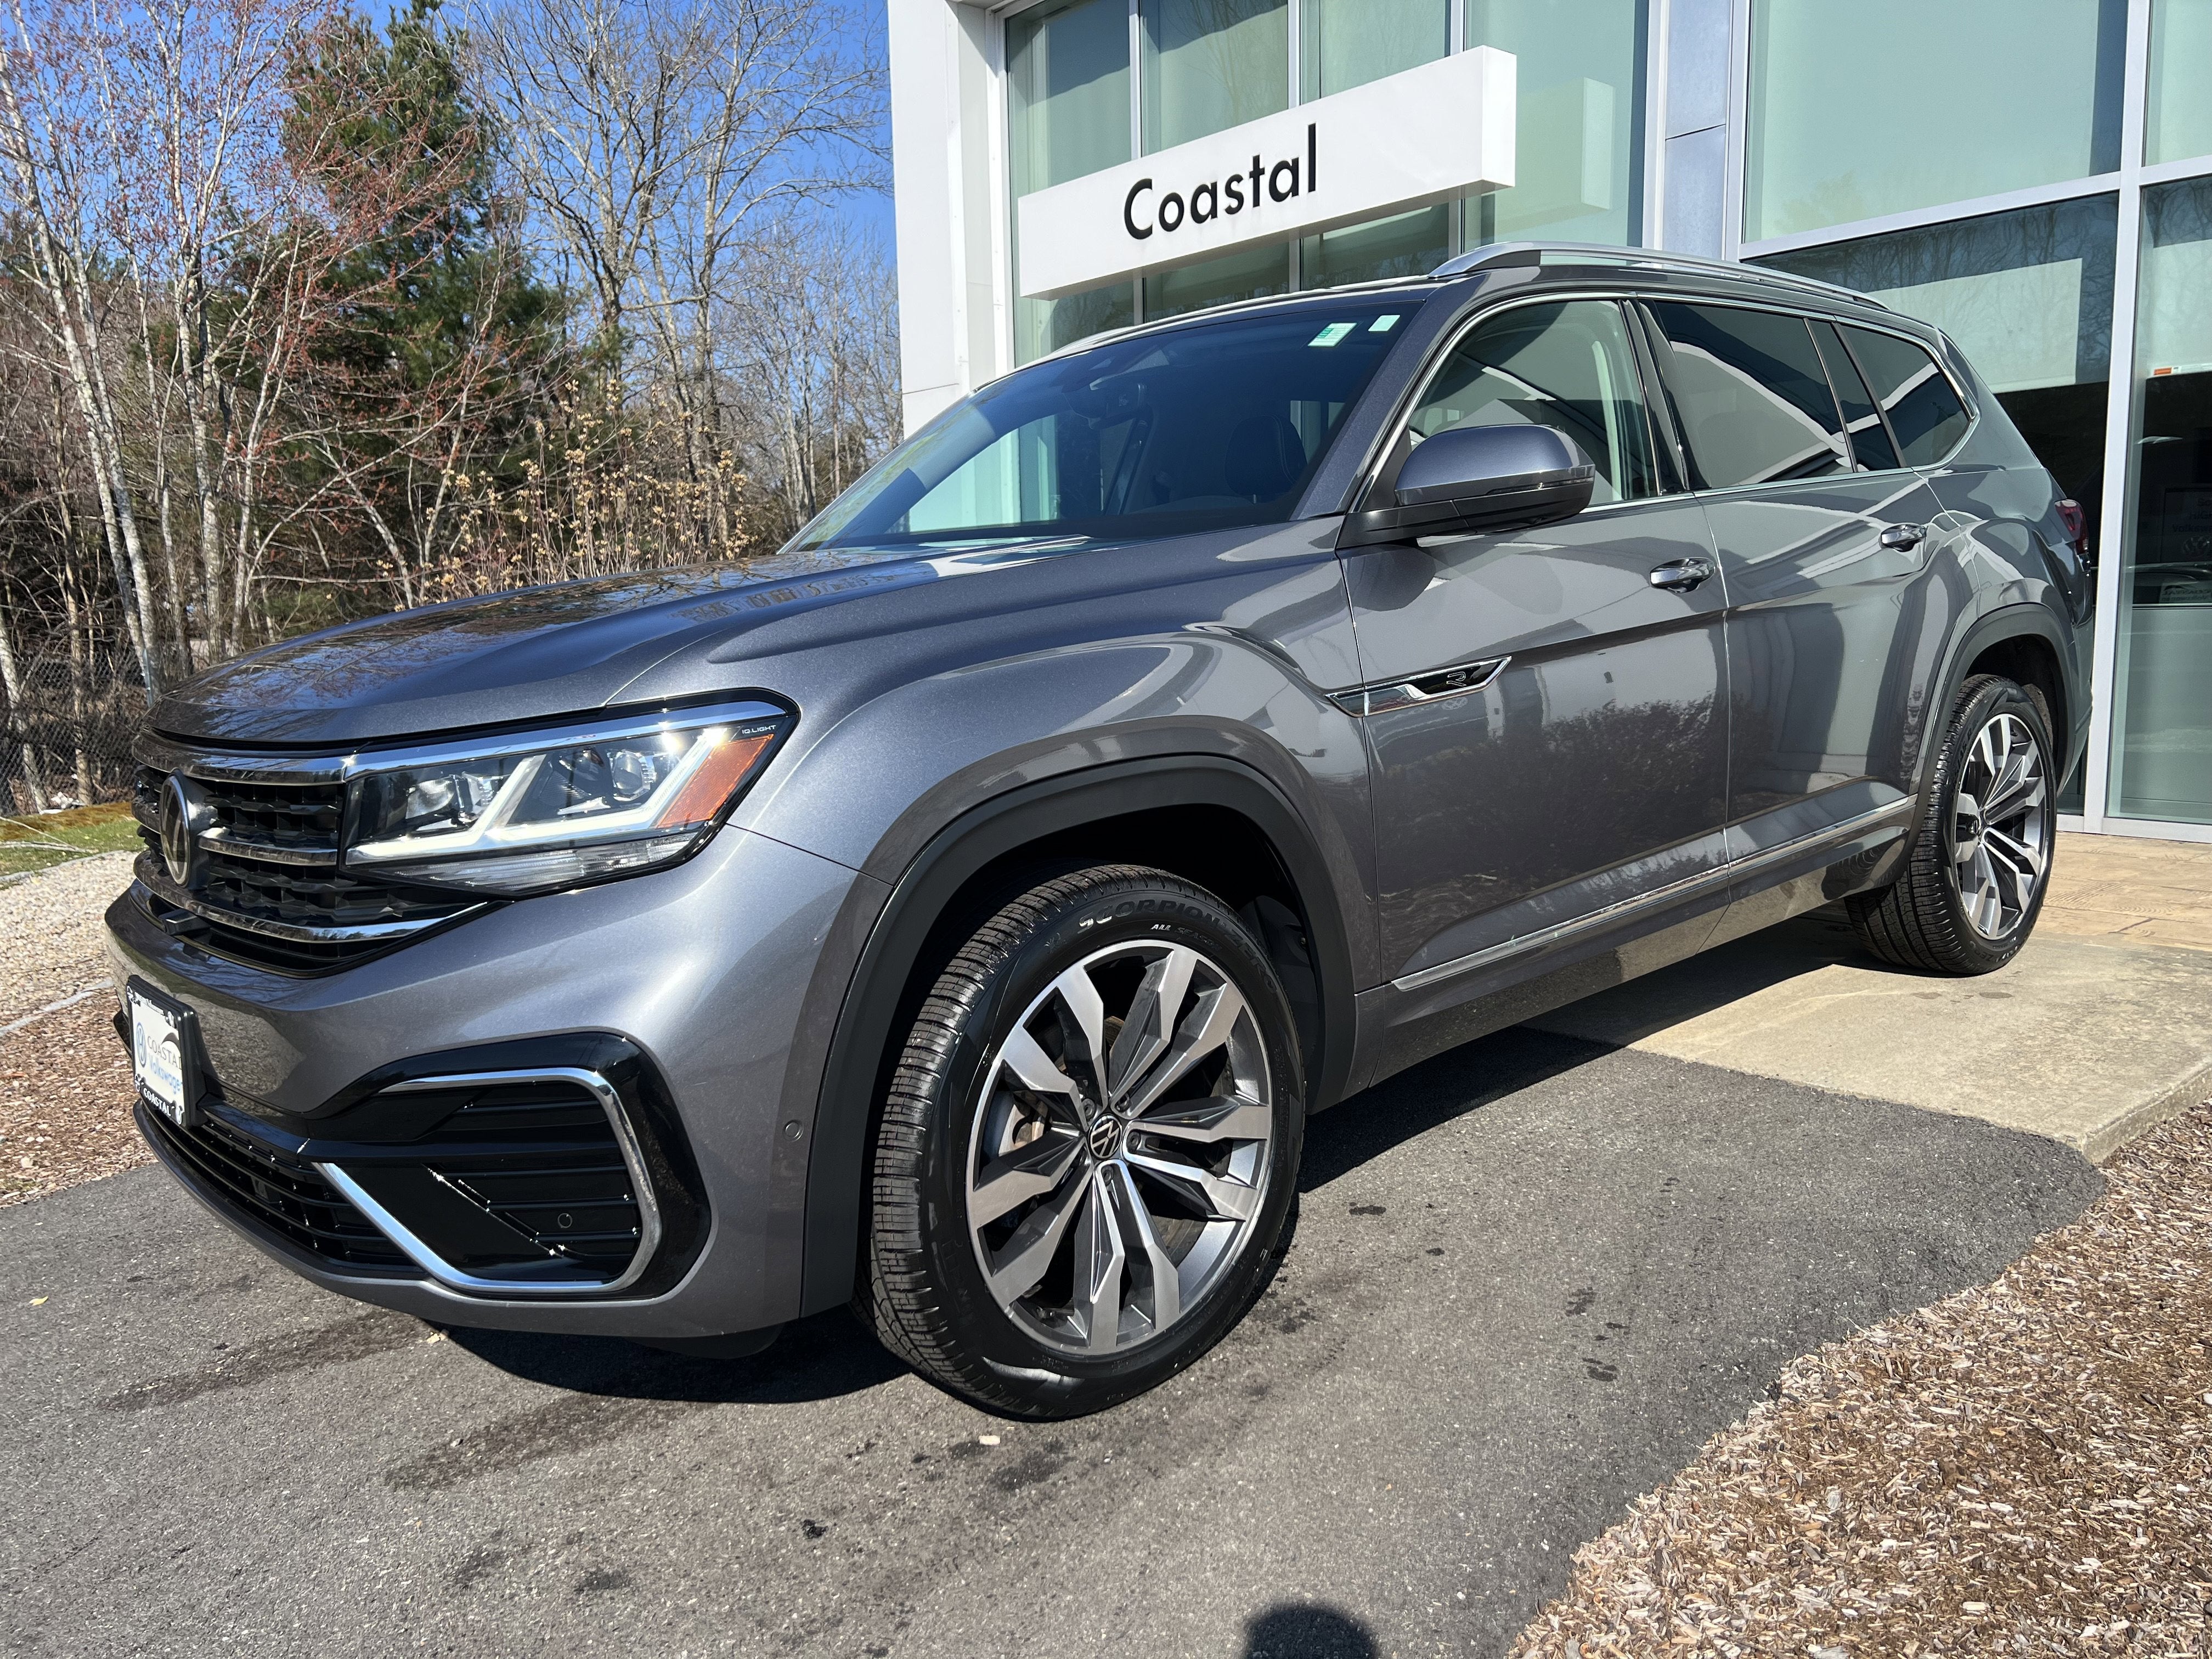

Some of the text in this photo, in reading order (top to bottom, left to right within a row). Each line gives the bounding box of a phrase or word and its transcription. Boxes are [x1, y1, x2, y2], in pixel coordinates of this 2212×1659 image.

[1124, 122, 1318, 240] Coastal
[1446, 671, 1467, 687] R
[742, 725, 777, 734] IQ.LIGHT
[1076, 899, 1278, 993] SCORPION ZERO
[1173, 926, 1222, 952] SEASON
[149, 1053, 183, 1094] Volkswage
[143, 1087, 171, 1117] COASTAL
